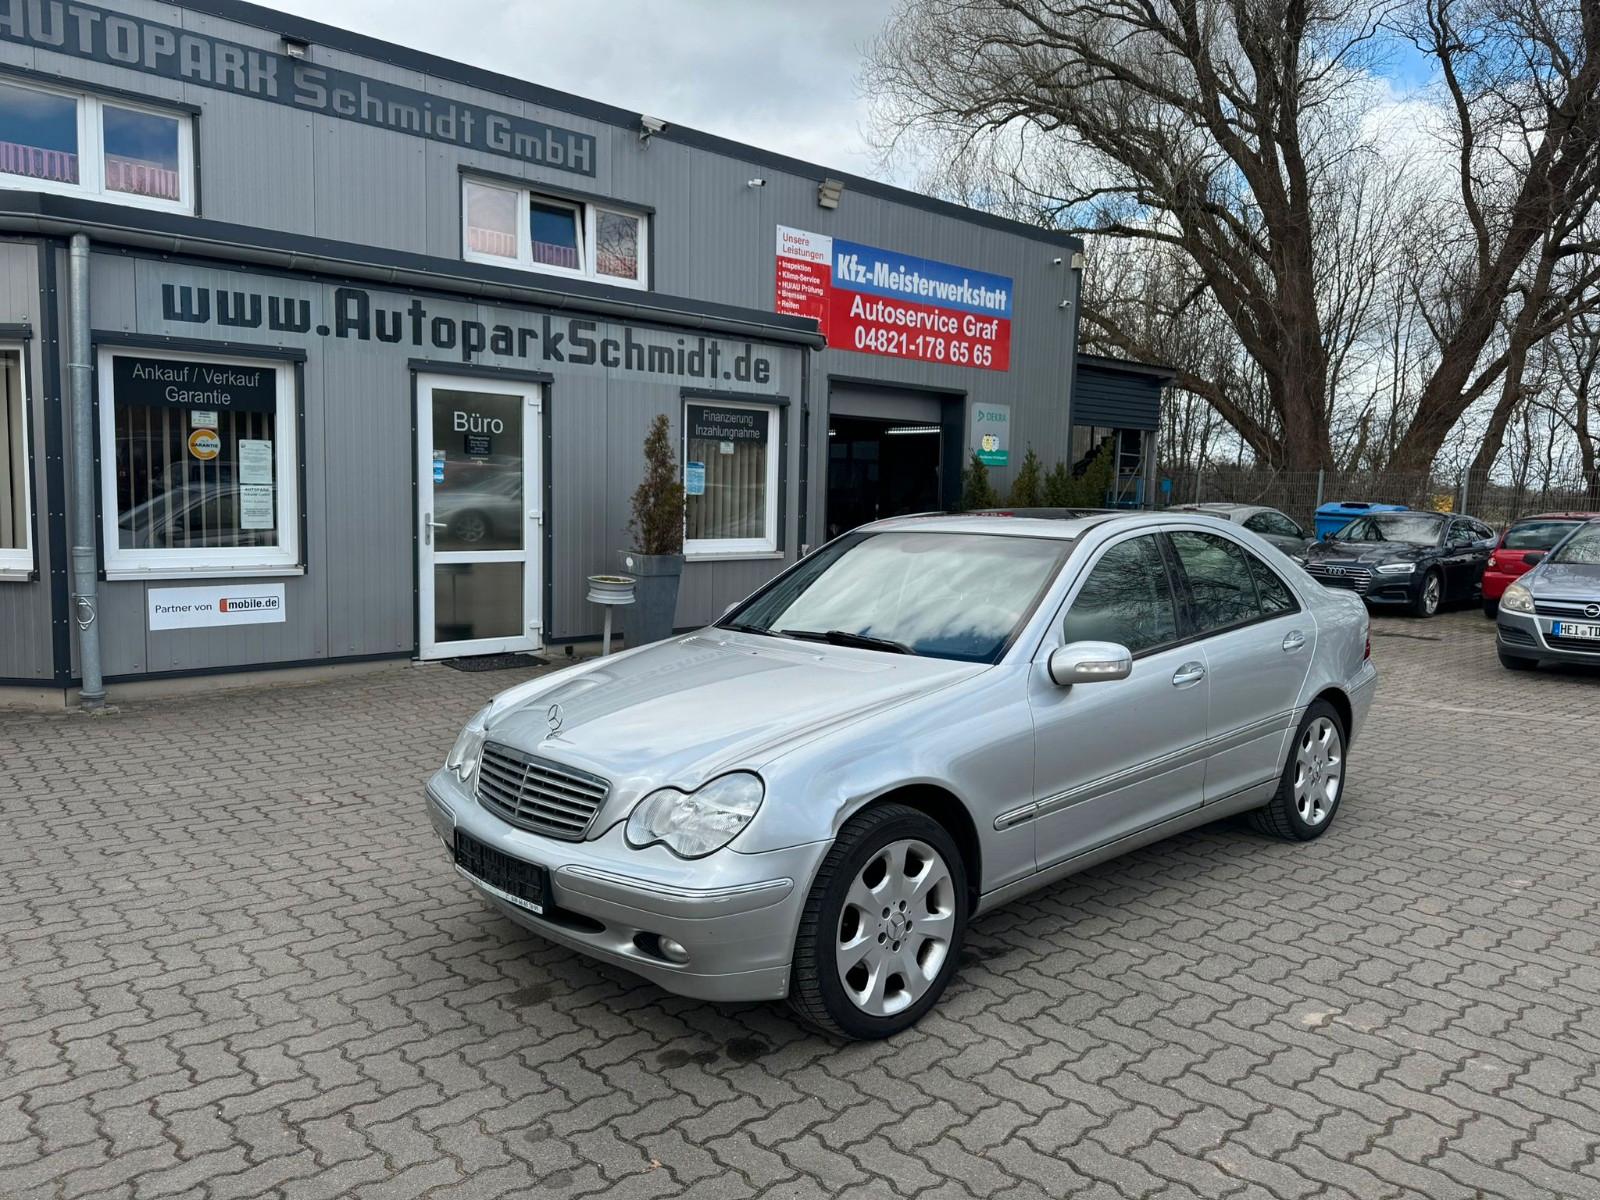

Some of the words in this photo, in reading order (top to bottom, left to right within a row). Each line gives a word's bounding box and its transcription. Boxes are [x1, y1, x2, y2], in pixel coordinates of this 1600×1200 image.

[293, 67, 474, 144] Schmidt
[485, 114, 592, 172] GmbH
[783, 233, 809, 246] Unsere
[783, 244, 823, 260] Leistungen
[782, 261, 811, 272] Inspektion
[782, 271, 820, 284] Klima-Service
[838, 253, 1007, 311] Kfz-Meisterwerkstatt
[782, 290, 806, 300] Bremsen
[801, 285, 823, 296] Prüfung
[782, 301, 799, 309] Reifen
[850, 295, 958, 334] Autoservice
[963, 315, 998, 340] Graf
[162, 284, 771, 384] www.AutoparkSchmidt.de
[855, 325, 945, 360] 04821-178
[950, 343, 969, 364] 65
[973, 346, 992, 367] 65
[132, 363, 190, 384] Ankauf
[202, 367, 260, 388] Verkauf
[165, 386, 232, 406] Garantie
[453, 411, 504, 434] Büro
[703, 409, 754, 427] Finanzierung
[695, 424, 761, 440] Inzahlungnahme
[155, 603, 192, 614] Partner
[194, 604, 213, 612] von
[228, 598, 277, 610] mobile.de
[1561, 624, 1579, 635] HEI
